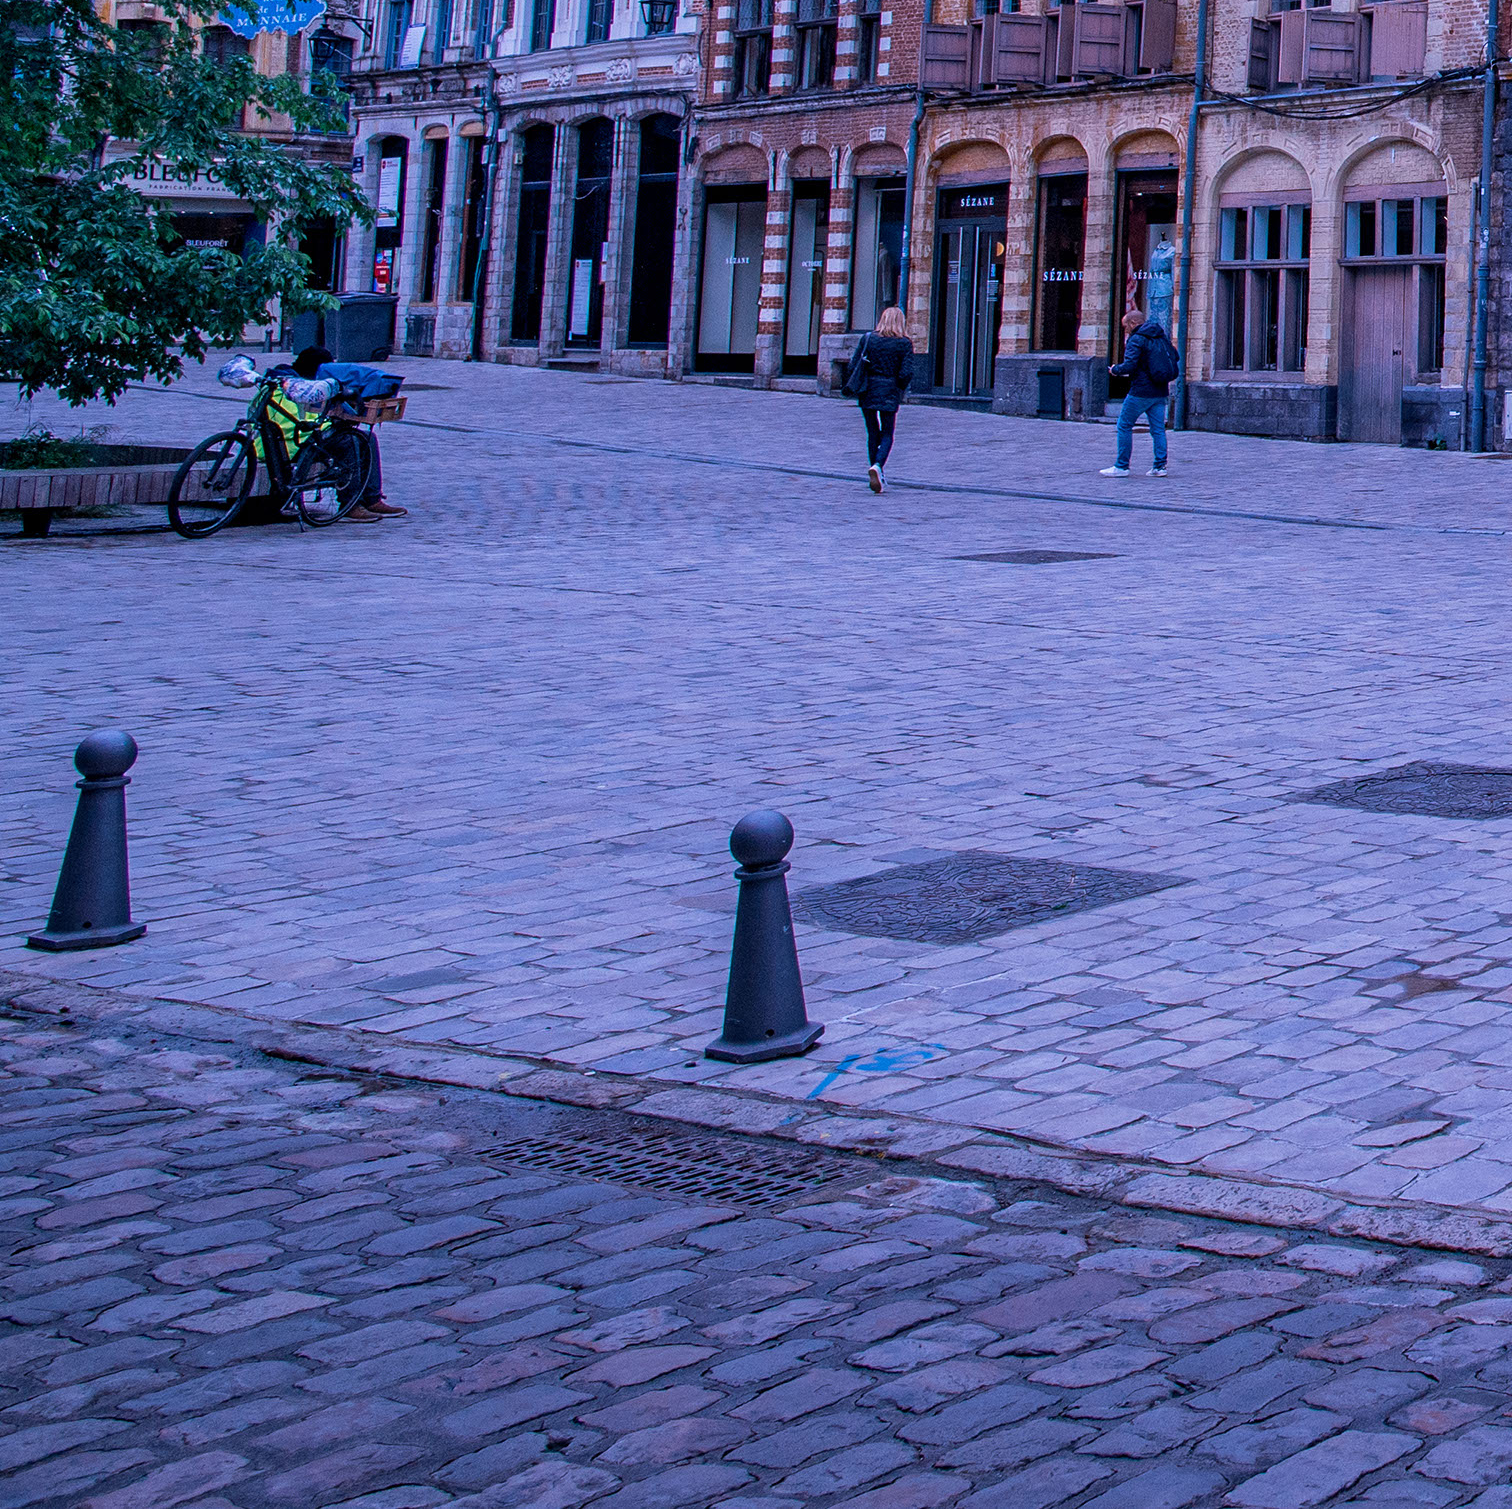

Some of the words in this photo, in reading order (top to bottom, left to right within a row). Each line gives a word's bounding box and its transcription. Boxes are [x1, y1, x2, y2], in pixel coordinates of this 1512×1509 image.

[236, 12, 307, 27] MNNAIE
[133, 163, 224, 184] BLEUFO
[960, 195, 995, 207] SÉZANE
[1042, 267, 1084, 282] SÉZANE
[1133, 269, 1164, 280] SÉZANE
